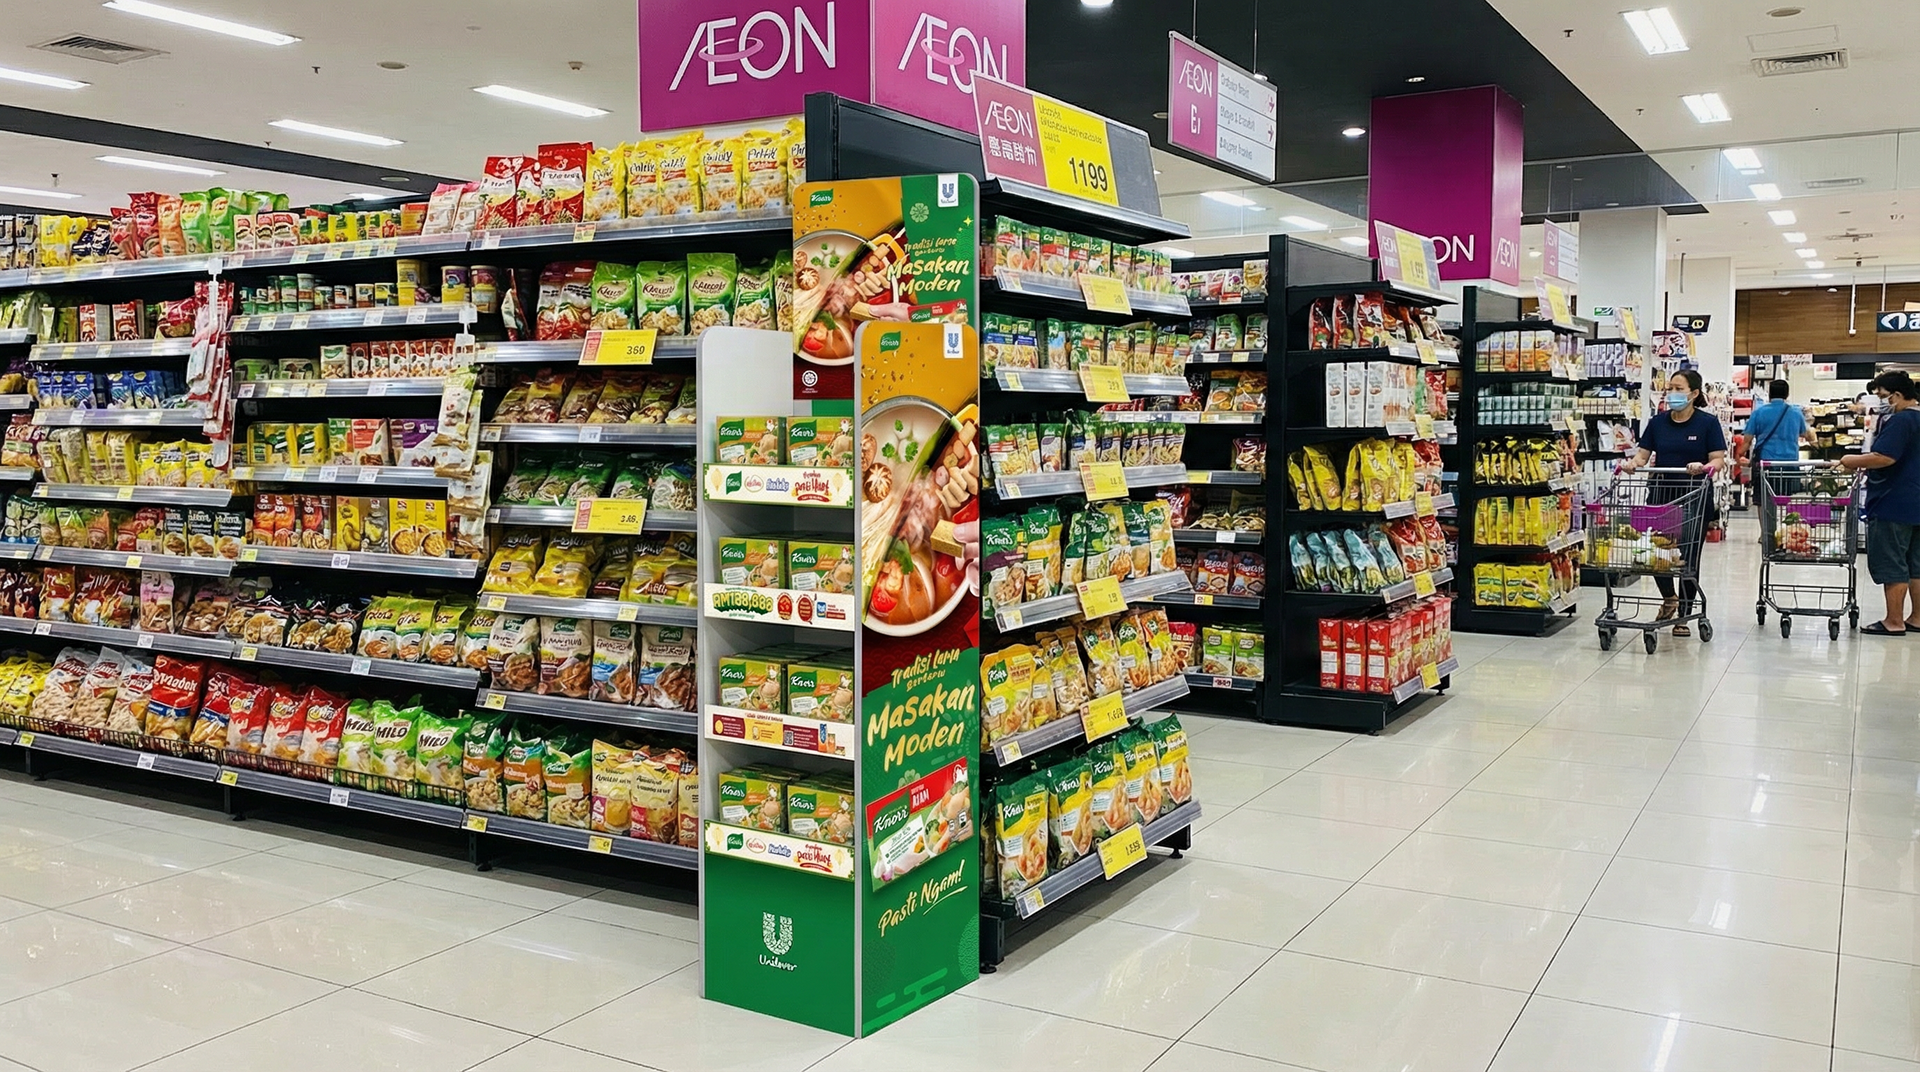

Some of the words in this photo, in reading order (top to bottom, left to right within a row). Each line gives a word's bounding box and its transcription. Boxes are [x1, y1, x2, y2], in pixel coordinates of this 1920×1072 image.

[1069, 157, 1108, 192] 1199
[886, 255, 970, 281] Masakan
[898, 273, 961, 297] Moden
[867, 682, 975, 747] Masakan
[376, 726, 408, 739] MILO
[419, 733, 449, 748] MILO
[883, 716, 965, 773] Moden
[873, 805, 909, 834] Knorr
[878, 891, 918, 938] Pasti
[920, 858, 966, 907] Ngam!
